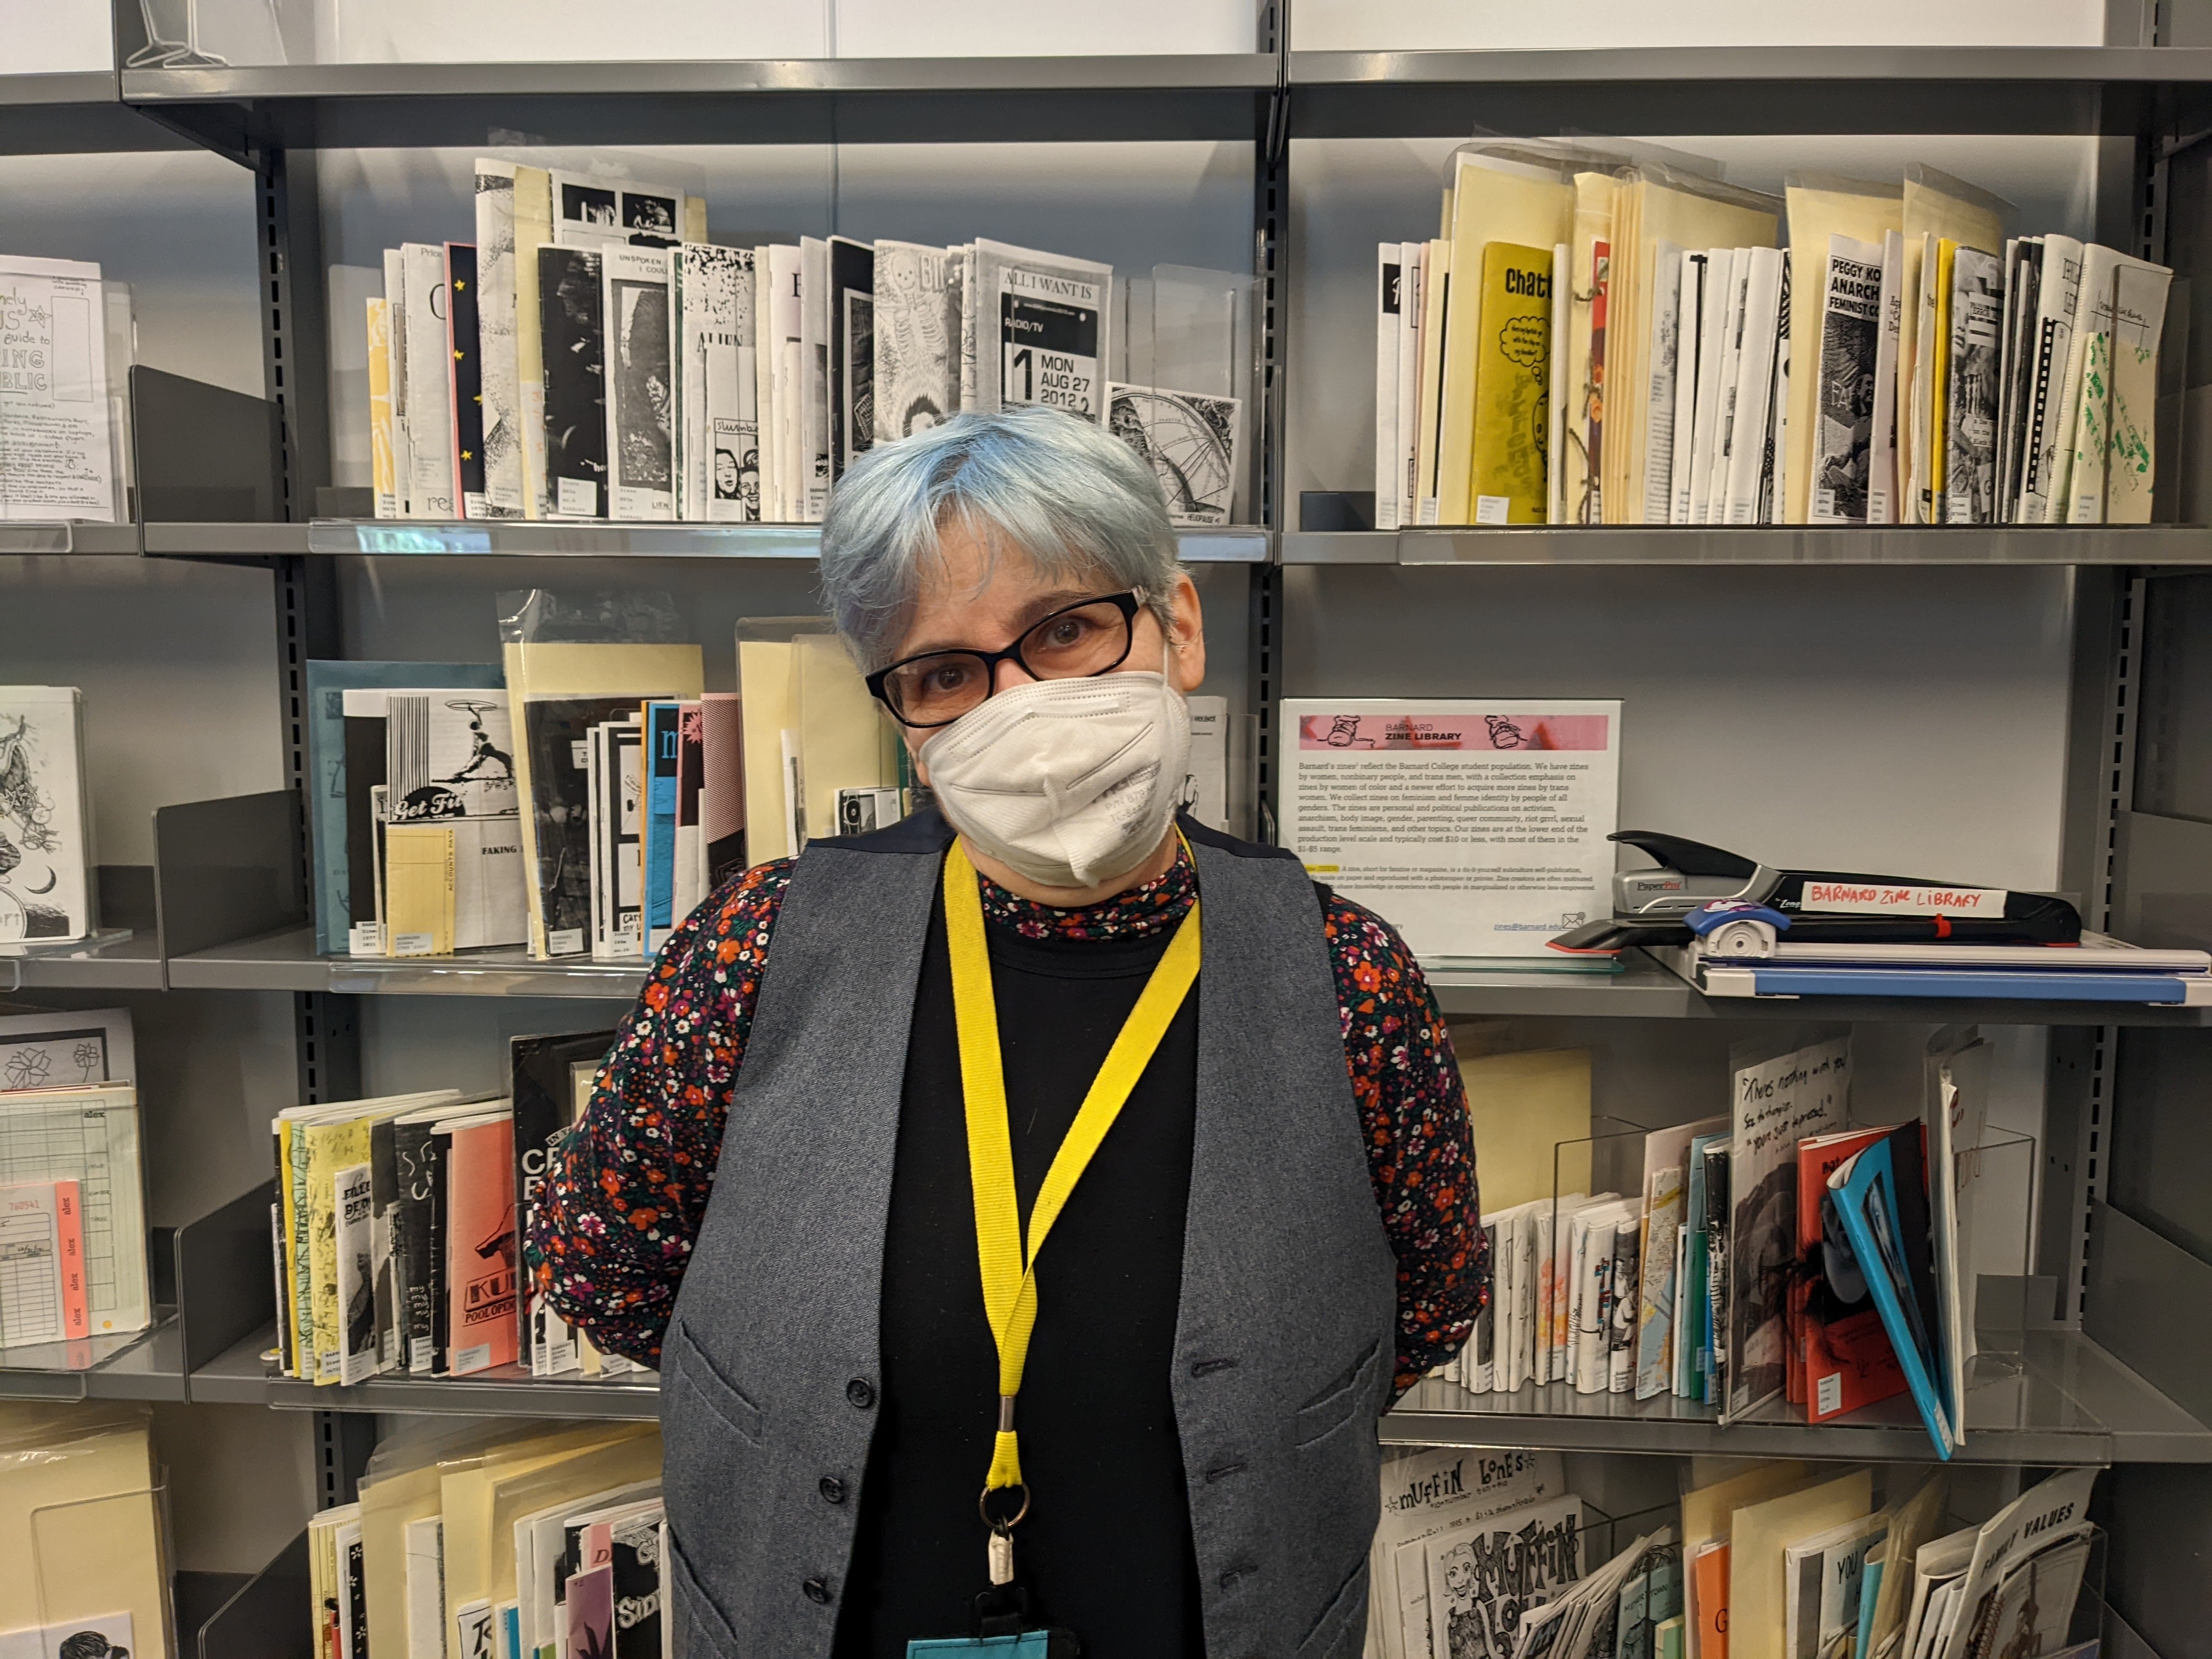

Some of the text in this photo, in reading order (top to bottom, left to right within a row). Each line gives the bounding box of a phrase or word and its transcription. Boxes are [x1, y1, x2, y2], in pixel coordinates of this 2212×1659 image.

[619, 255, 662, 264] UNSPOKEN
[1832, 259, 1864, 279] PEGGY
[1005, 272, 1092, 300] ALL I WANT IS
[1830, 277, 1880, 302] ANARCH
[1830, 296, 1868, 315] FEMINIST
[1005, 317, 1043, 333] RADIO/TV
[4, 331, 50, 345] guide to
[1041, 355, 1074, 374] MON
[1014, 349, 1032, 401] 1
[1041, 372, 1090, 393] AUG 27
[1041, 389, 1076, 408] 2012
[1431, 763, 1460, 771] College
[1299, 773, 1308, 781] by
[1340, 773, 1378, 781] nonbinary
[1528, 773, 1565, 781] emphasis
[394, 792, 462, 821] Get Fit
[1481, 794, 1509, 802] identity
[1511, 794, 1521, 802] by
[1522, 794, 1547, 802] people
[1382, 804, 1414, 812] personal
[1432, 804, 1462, 812] political
[1463, 804, 1510, 812] publications
[1340, 815, 1359, 823] body
[1297, 835, 1338, 843] production
[1394, 835, 1426, 843] typically
[482, 845, 517, 855] FAKING
[1637, 881, 1681, 891] PaperPro
[1812, 885, 1877, 904] BARNARD
[84, 1110, 106, 1119] alex
[63, 1197, 71, 1216] alex
[68, 1238, 76, 1257] alex
[72, 1273, 80, 1291] alex
[72, 1307, 81, 1327] alex
[465, 1307, 490, 1323] POOL
[2023, 1502, 2075, 1540] VALUES
[1837, 1551, 1858, 1585] YOU
